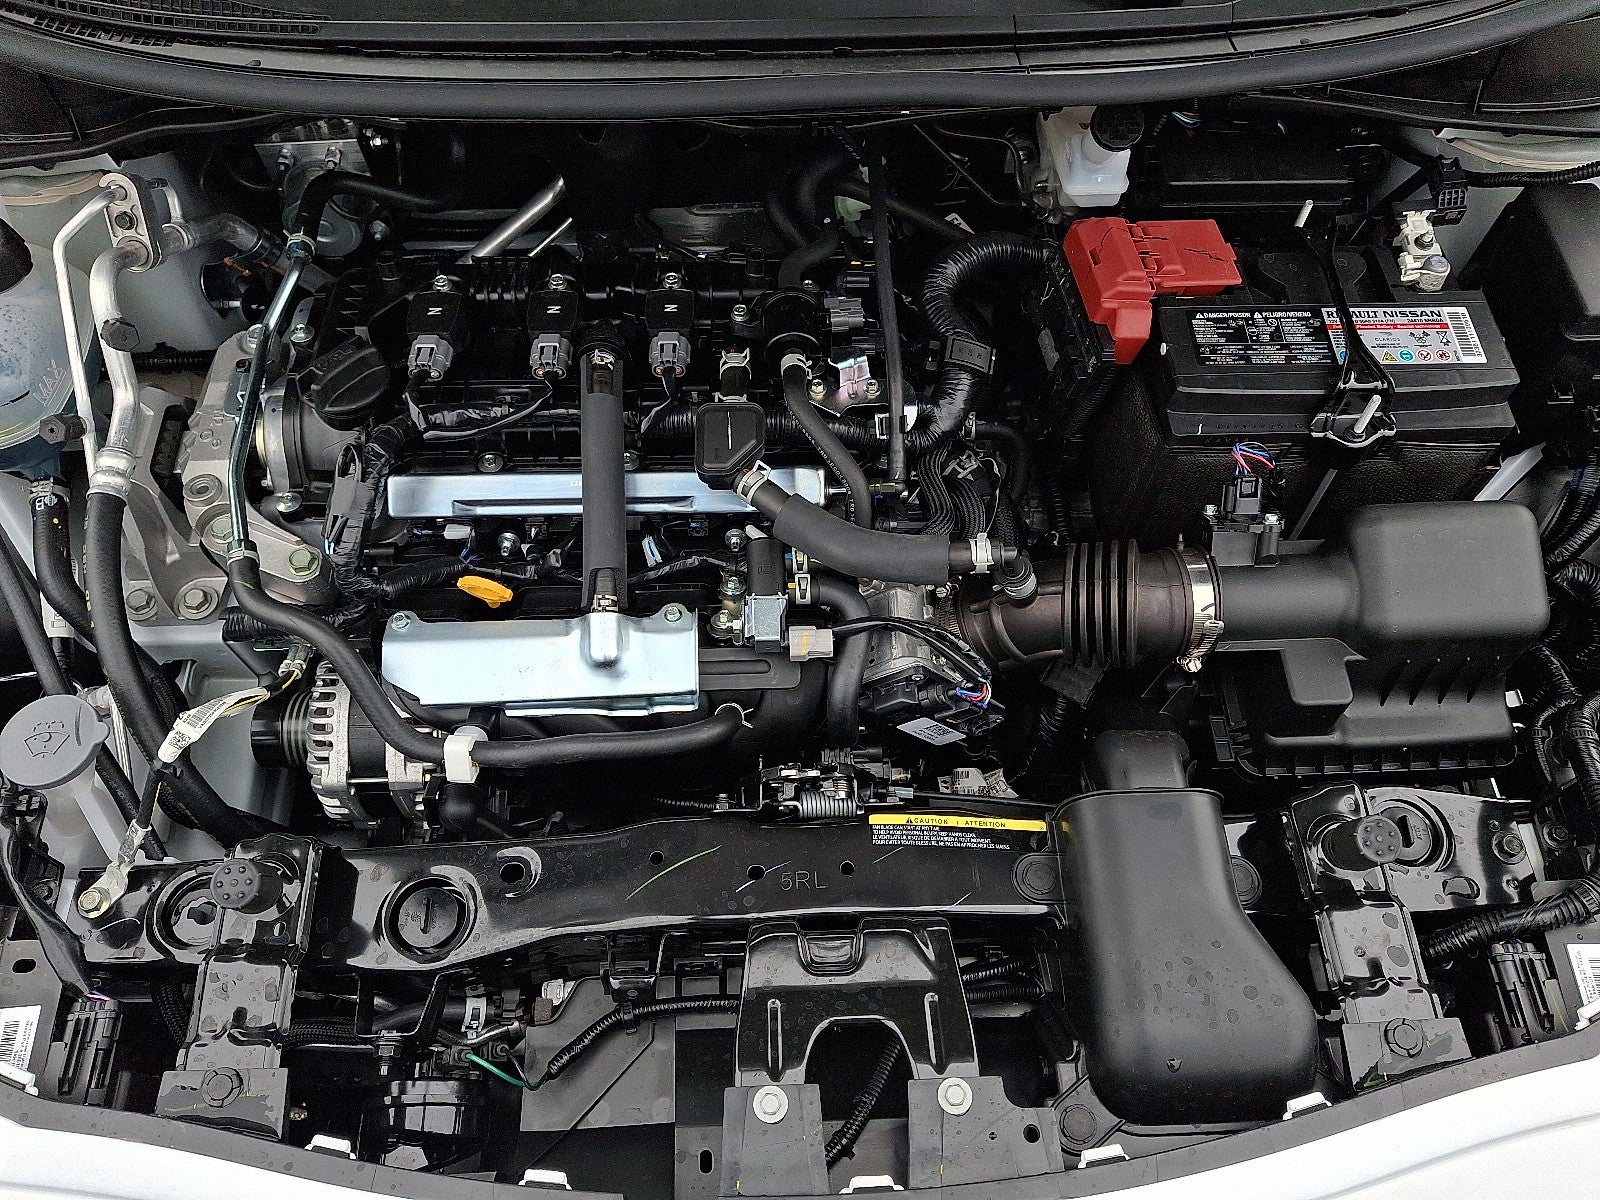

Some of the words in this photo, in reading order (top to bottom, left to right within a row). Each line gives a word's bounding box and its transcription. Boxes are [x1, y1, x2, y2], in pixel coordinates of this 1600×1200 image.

[1382, 310, 1443, 318] NISSAN
[913, 817, 949, 825] CAUTION
[964, 820, 1006, 828] ATTENTION
[780, 869, 827, 891] 5RL
